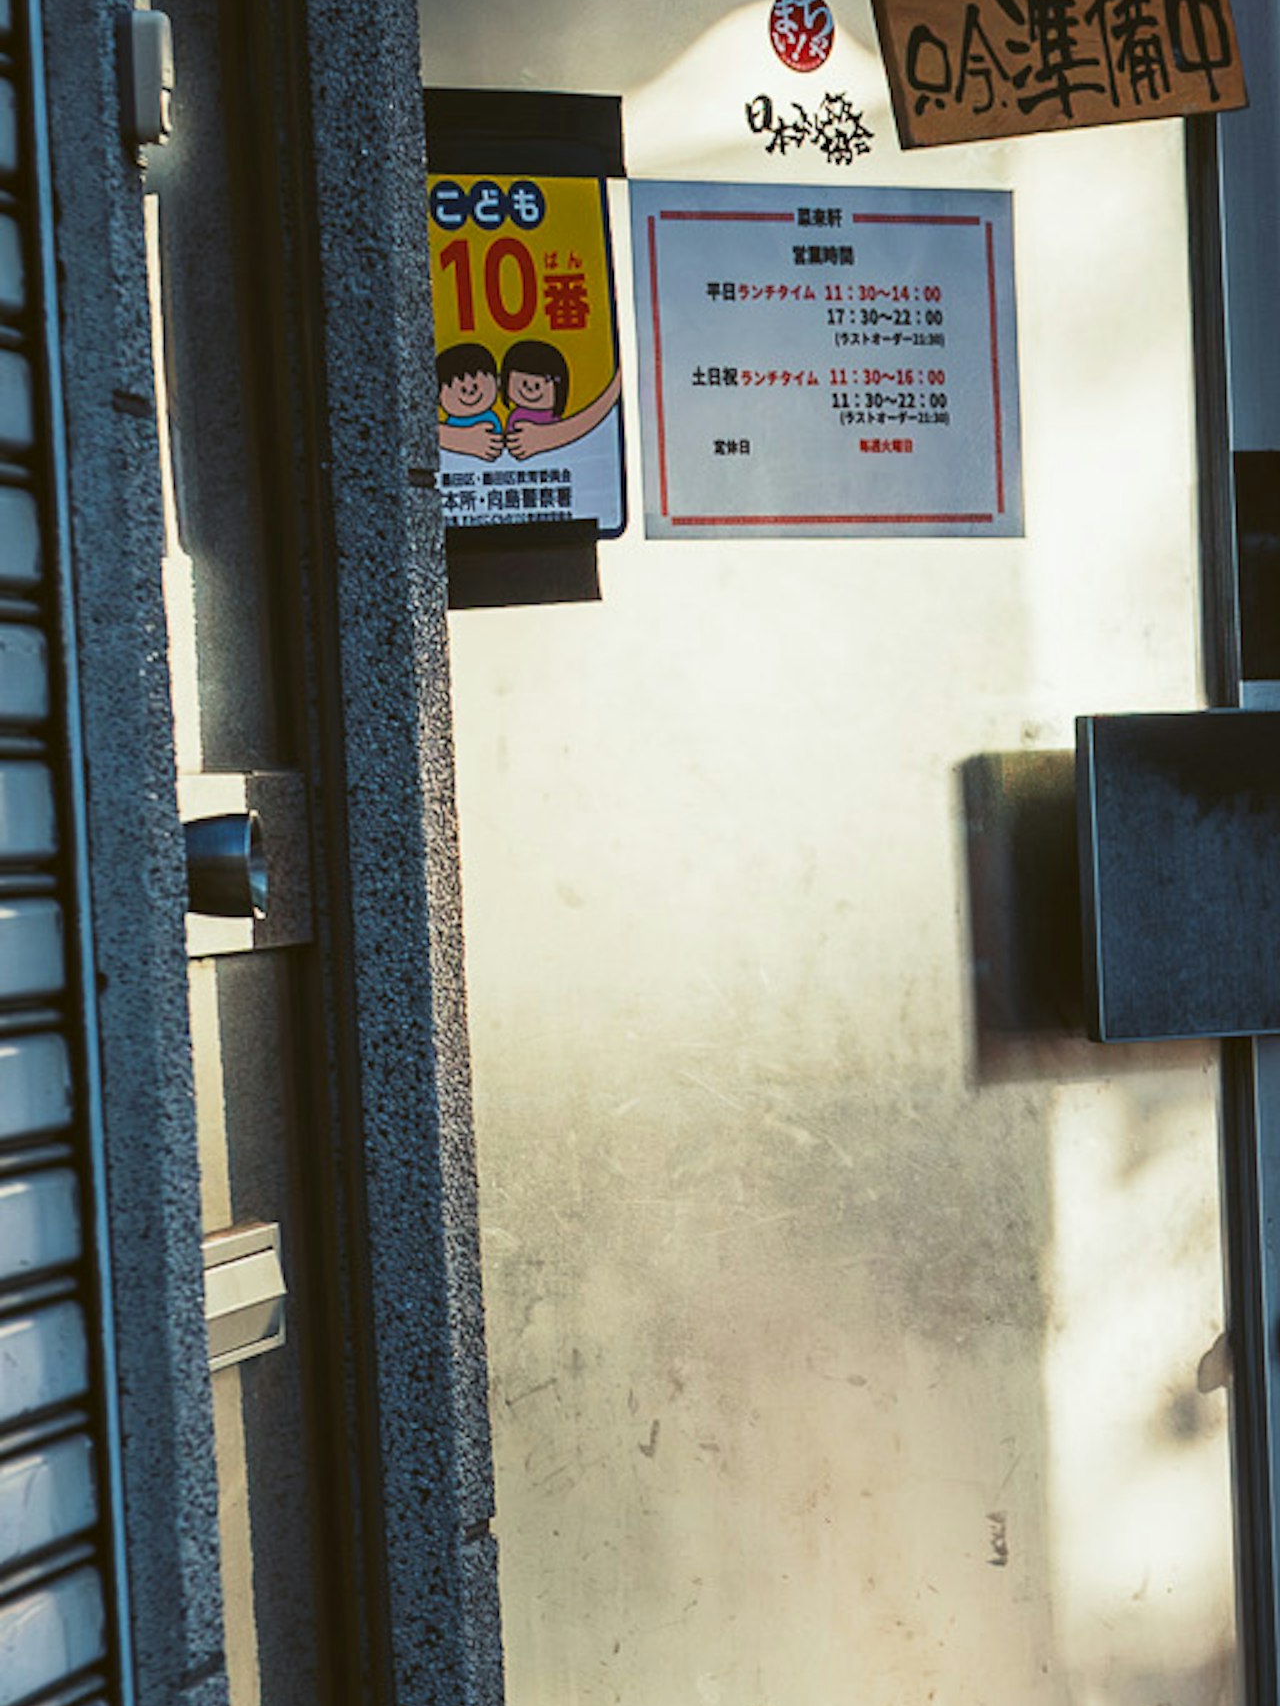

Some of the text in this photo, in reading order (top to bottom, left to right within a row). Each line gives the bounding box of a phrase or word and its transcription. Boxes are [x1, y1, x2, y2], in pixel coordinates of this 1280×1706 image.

[436, 189, 540, 223] こども
[543, 250, 583, 270] ばん
[793, 245, 854, 266] 営業時間
[713, 439, 912, 456] 定休日 毎週火曜日
